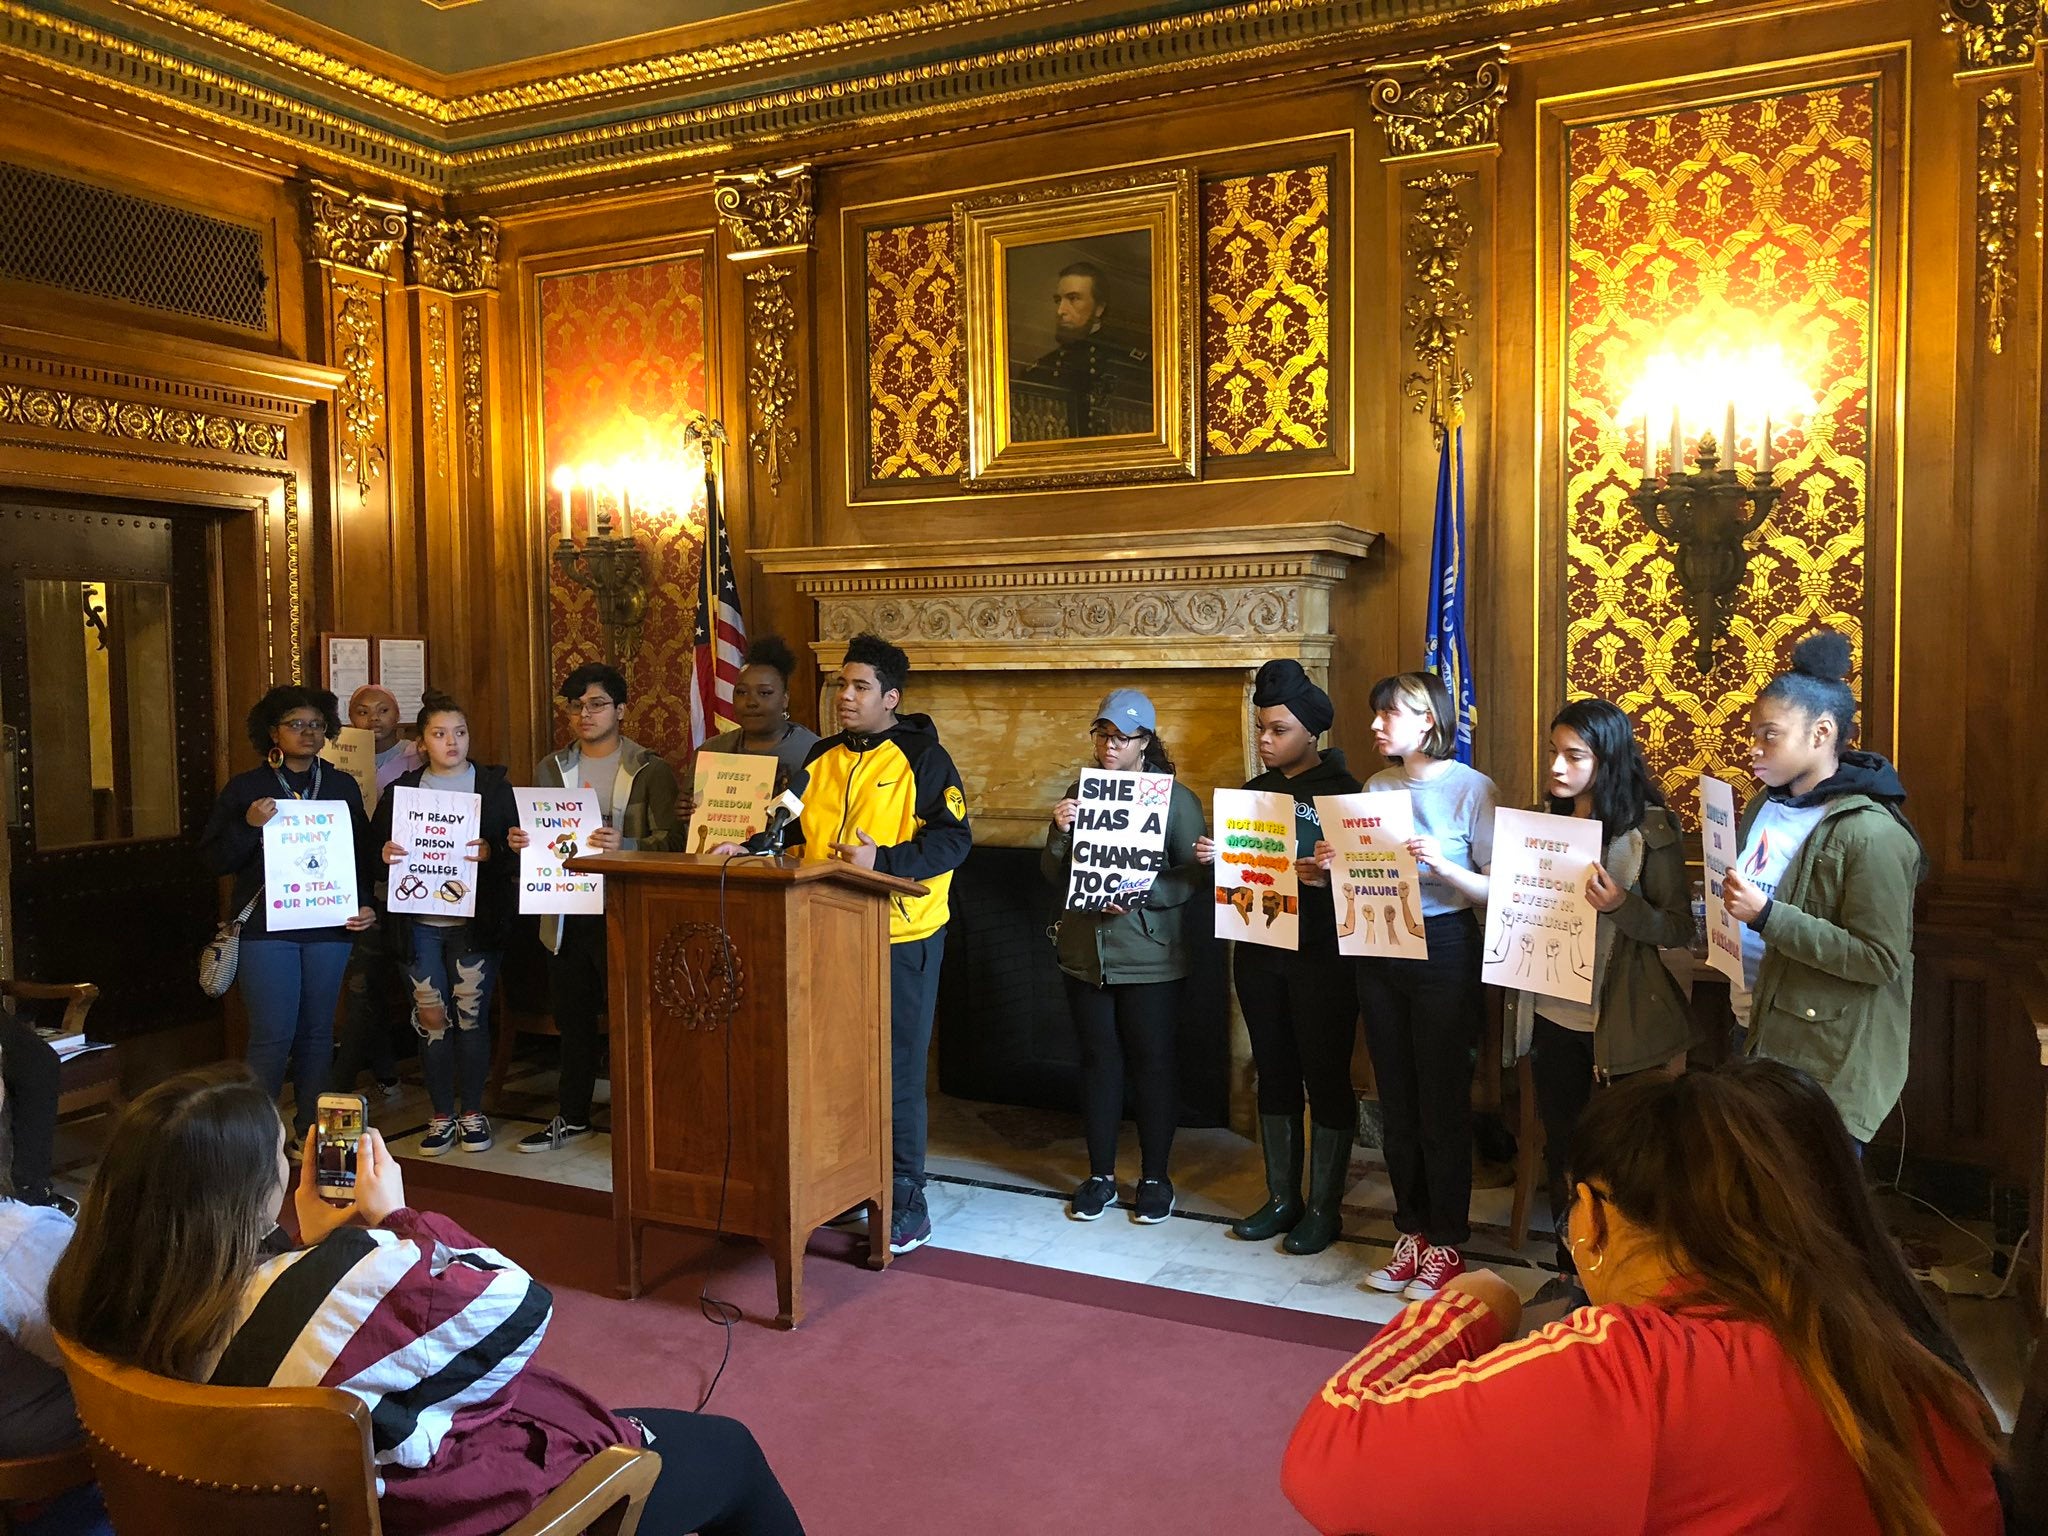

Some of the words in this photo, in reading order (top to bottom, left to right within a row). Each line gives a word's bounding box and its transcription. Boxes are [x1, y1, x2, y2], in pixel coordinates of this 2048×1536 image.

[717, 771, 751, 781] INVEST
[726, 786, 737, 794] IN
[1082, 778, 1135, 802] SHE
[532, 801, 551, 812] ITS
[556, 802, 583, 812] NOT
[707, 799, 752, 810] FREEDOM
[304, 814, 334, 825] NOT
[409, 811, 424, 821] I'M
[428, 812, 465, 824] READY
[535, 818, 582, 828] FUNNY
[707, 813, 738, 823] DIVEST
[739, 815, 750, 824] IN
[1077, 808, 1129, 831] HAS
[1140, 812, 1161, 834] A
[1342, 817, 1381, 828] INVEST
[425, 826, 446, 835] FOR
[708, 827, 746, 837] FAILURE
[1227, 819, 1251, 831] NOT
[1253, 821, 1265, 832] IN
[1266, 823, 1287, 836] THE
[281, 830, 331, 844] FUNNY
[1359, 835, 1372, 845] IN
[415, 838, 455, 849] PRISON
[1227, 836, 1263, 849] MOOD
[1263, 839, 1286, 853] FOR
[1524, 837, 1570, 854] INVEST
[423, 852, 446, 861] NOT
[1074, 841, 1166, 872] CHANCE
[1344, 851, 1396, 861] FREEDOM
[409, 864, 458, 876] COLLEGE
[1539, 858, 1552, 871] IN
[536, 867, 552, 877] TO
[1349, 868, 1384, 878] DIVEST
[1387, 868, 1400, 878] IN
[283, 883, 301, 893] TO
[305, 881, 341, 892] STEAL
[527, 883, 552, 892] OUR
[556, 883, 598, 892] MONEY
[1073, 870, 1102, 894] TO
[1513, 874, 1576, 893] FREEDOM
[1354, 885, 1398, 896] FAILURE
[273, 898, 301, 909] OUR
[305, 894, 351, 907] MONEY
[1512, 892, 1559, 909] DIVEST
[1560, 900, 1575, 912] IN
[1514, 912, 1569, 931] FAILURE
